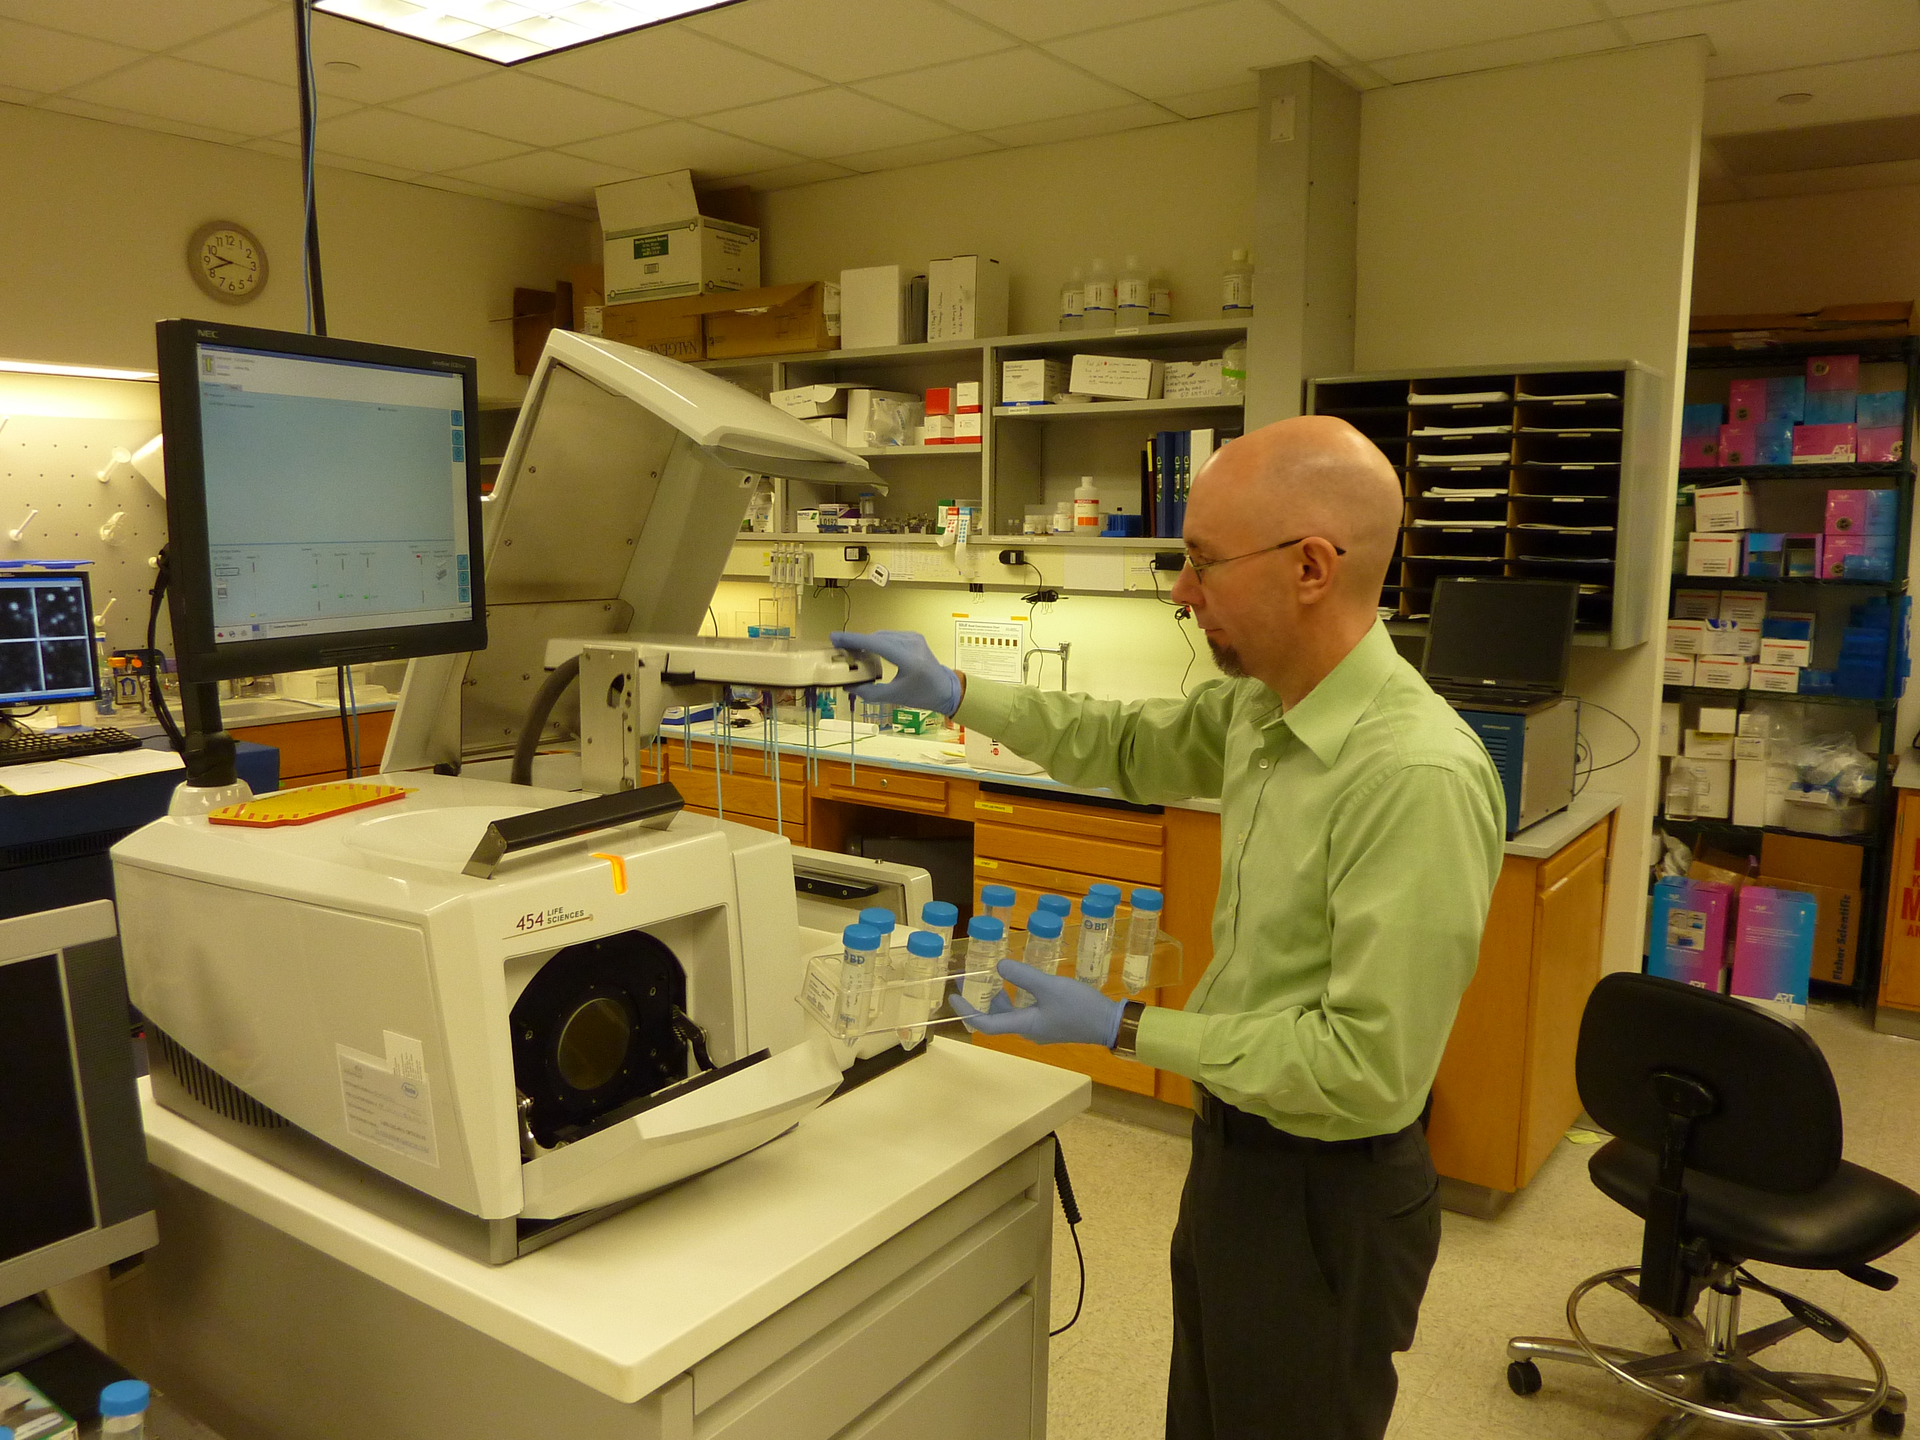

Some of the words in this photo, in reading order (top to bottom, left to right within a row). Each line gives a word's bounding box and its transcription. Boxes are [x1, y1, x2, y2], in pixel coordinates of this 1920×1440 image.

[216, 236, 223, 247] 11
[225, 235, 235, 246] 12
[239, 240, 243, 250] 1
[207, 244, 218, 256] 10
[246, 248, 252, 258] 2
[204, 256, 210, 265] 9
[250, 262, 256, 272] 3
[209, 268, 216, 278] 8
[247, 274, 252, 282] 4
[219, 276, 226, 287] 7
[238, 280, 244, 290] 5
[228, 282, 235, 292] 6
[197, 329, 219, 338] NEC
[1832, 444, 1852, 454] ART
[547, 906, 564, 916] LIFE
[516, 911, 544, 930] 454
[547, 910, 584, 924] SCIENCES
[1094, 922, 1108, 930] BD
[850, 954, 865, 964] BD
[1833, 947, 1845, 980] Fisher
[1774, 992, 1795, 1004] ART
